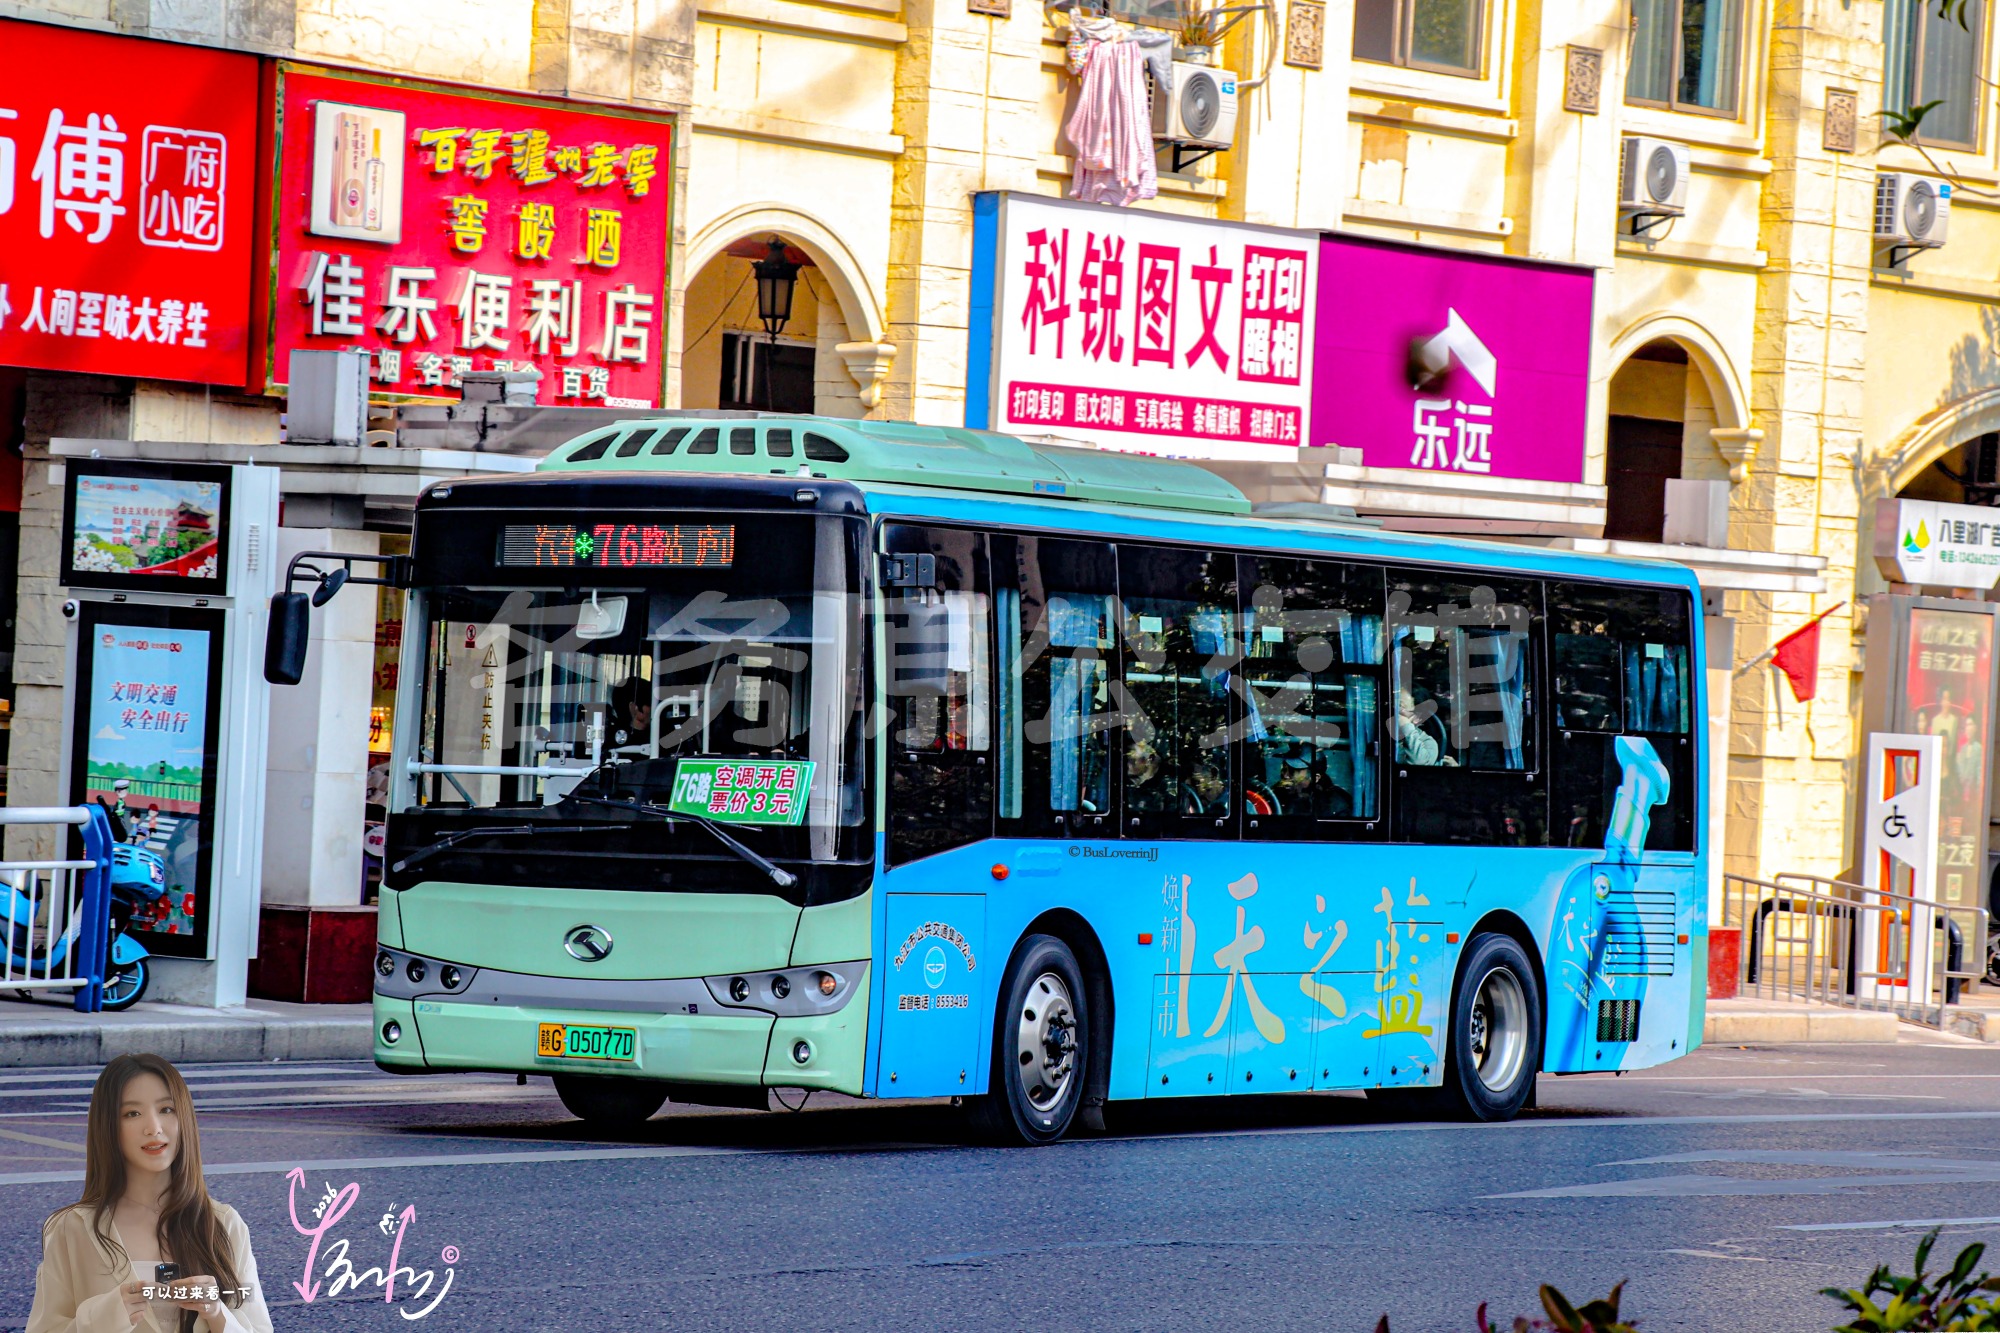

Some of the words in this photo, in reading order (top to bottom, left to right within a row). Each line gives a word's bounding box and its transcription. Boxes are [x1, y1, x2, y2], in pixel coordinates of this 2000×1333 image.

[0, 108, 127, 243] 傅
[149, 137, 219, 188] 广府
[146, 189, 217, 240] 小吃
[451, 193, 622, 268] 窖龄酒
[304, 251, 654, 363] 佳乐便利店
[1021, 227, 1233, 374] 科锐图文
[1245, 253, 1304, 314] 打印
[20, 286, 209, 348] 人间至味大养生
[1241, 317, 1300, 379] 照相
[562, 367, 609, 398] 百货
[1013, 387, 1065, 420] 打印复印
[1074, 392, 1125, 426] 图文印刷
[1410, 398, 1493, 473] 乐远
[108, 681, 178, 706] 文明交通
[120, 708, 190, 733] 安全出行
[481, 672, 495, 750] 防止夹伤
[677, 772, 712, 804] 76路
[708, 791, 792, 814] 票价3元
[714, 765, 797, 790] 空调开启
[1157, 873, 1180, 1039] 焕新上市
